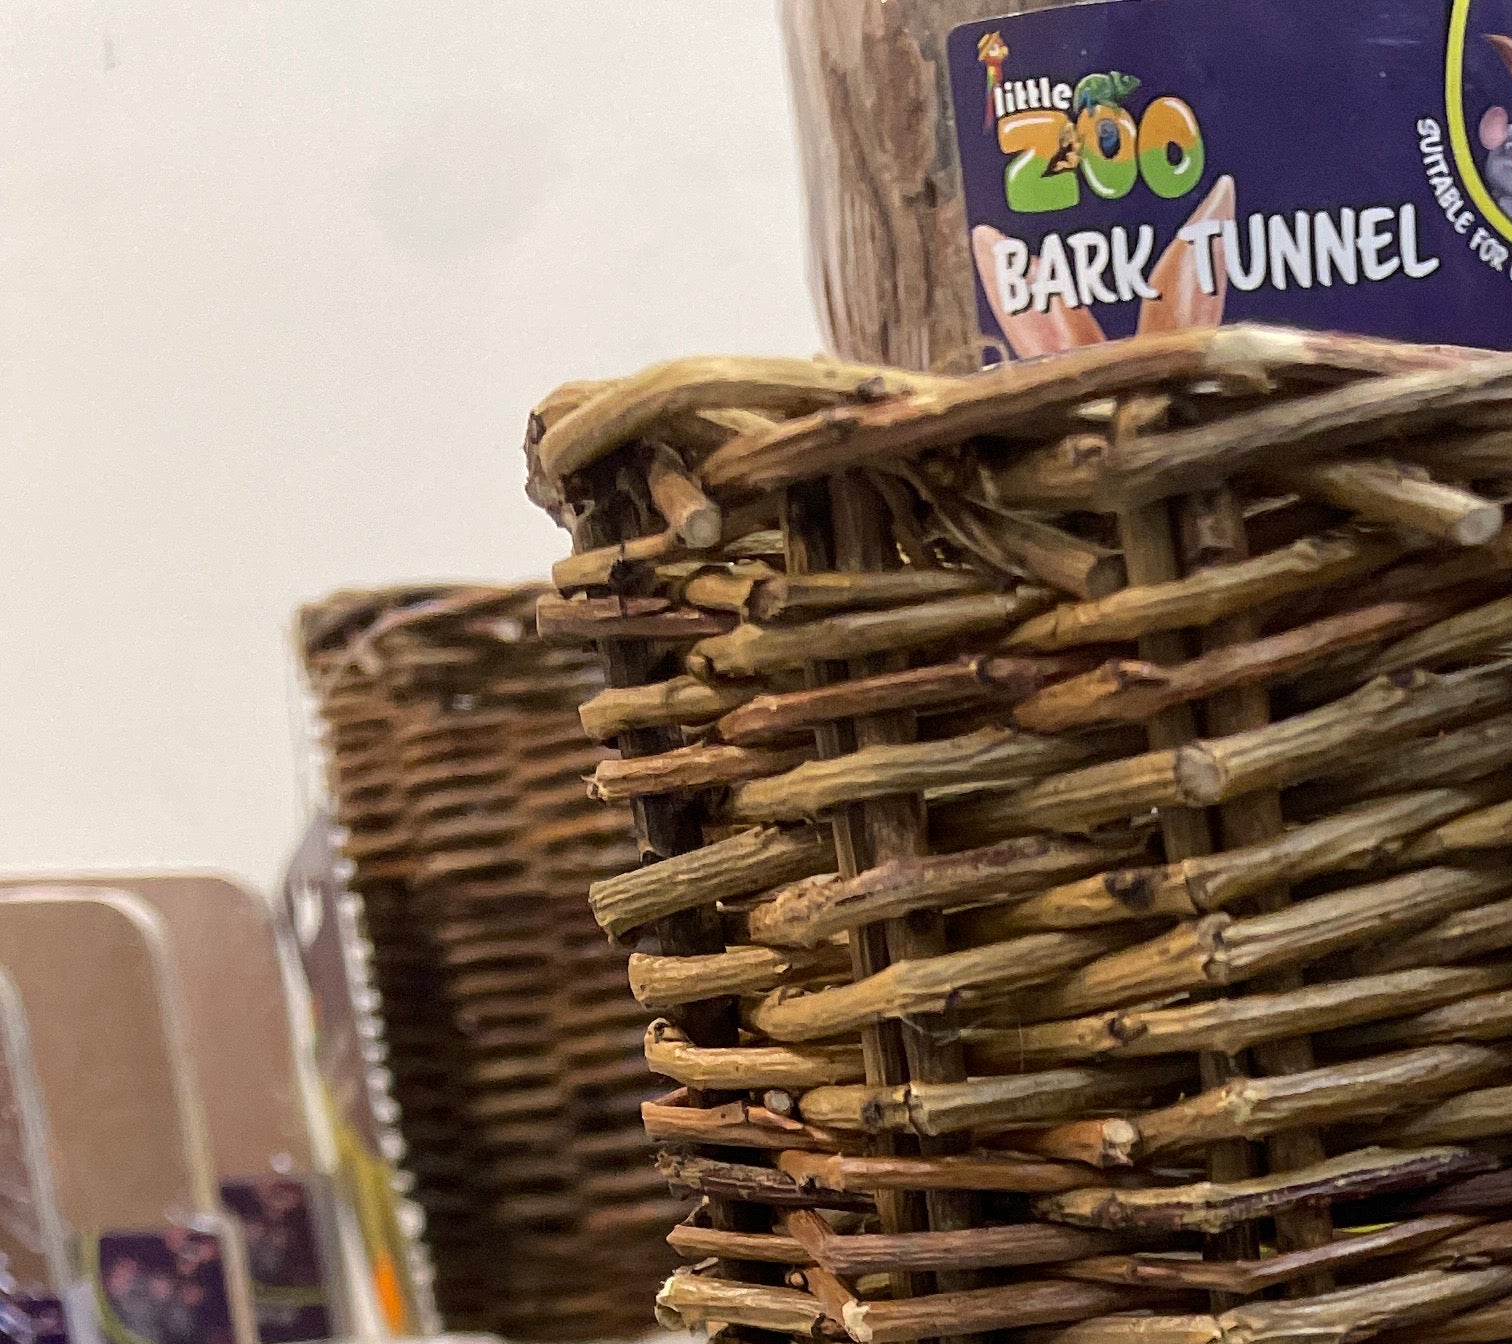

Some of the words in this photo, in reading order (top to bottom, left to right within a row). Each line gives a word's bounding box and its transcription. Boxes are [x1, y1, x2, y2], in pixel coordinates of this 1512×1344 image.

[994, 77, 1072, 112] little
[1416, 118, 1476, 234] SUITABLE
[1469, 227, 1509, 272] FOR
[994, 223, 1161, 316] BARK
[1184, 202, 1439, 294] TUNNEL
